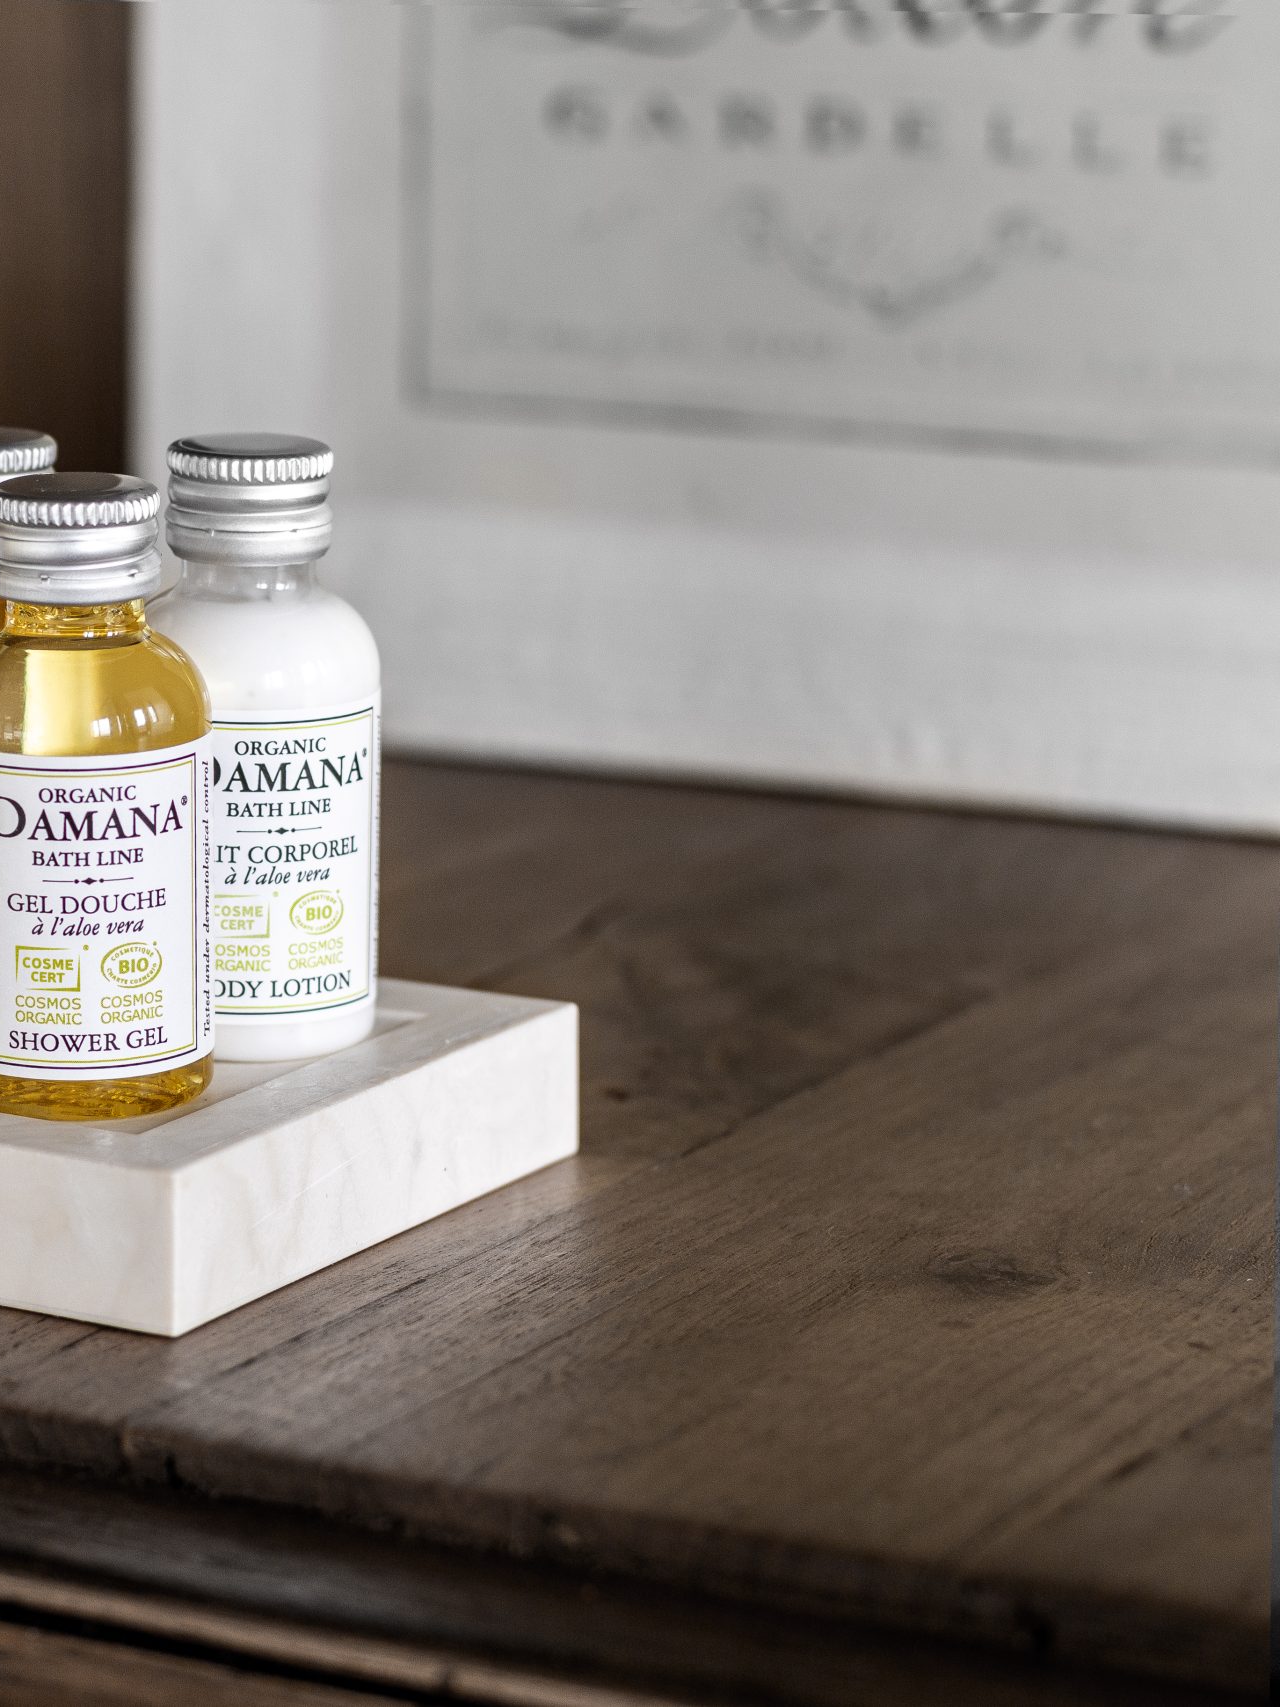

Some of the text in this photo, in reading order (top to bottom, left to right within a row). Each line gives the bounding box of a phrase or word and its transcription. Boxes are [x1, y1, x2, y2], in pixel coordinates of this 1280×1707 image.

[234, 737, 326, 756] ORGANIC
[38, 785, 136, 804] ORGANIC
[226, 798, 331, 818] BATH LINE
[32, 847, 144, 867] BATH LINE
[248, 835, 358, 864] CORPOREL
[202, 819, 210, 933] dermatological
[224, 867, 237, 885] à
[296, 868, 330, 883] vera
[7, 888, 166, 915] GEL DOUCHE
[306, 905, 333, 921] BIO
[32, 917, 43, 936] à
[107, 919, 144, 935] vera
[220, 919, 255, 930] CERT
[288, 937, 344, 956] COSMOS
[22, 957, 73, 971] COSME
[119, 957, 149, 974] BIO
[288, 951, 343, 970] ORGANIC
[31, 971, 66, 983] CERT
[270, 970, 352, 998] LOTION
[16, 994, 82, 1010] COSMOS
[100, 990, 163, 1009] COSMOS
[15, 1010, 82, 1025] ORGANIC
[100, 1005, 163, 1024] ORGANIC
[203, 988, 211, 1036] Tested
[9, 1026, 168, 1052] SHOWER GEL
